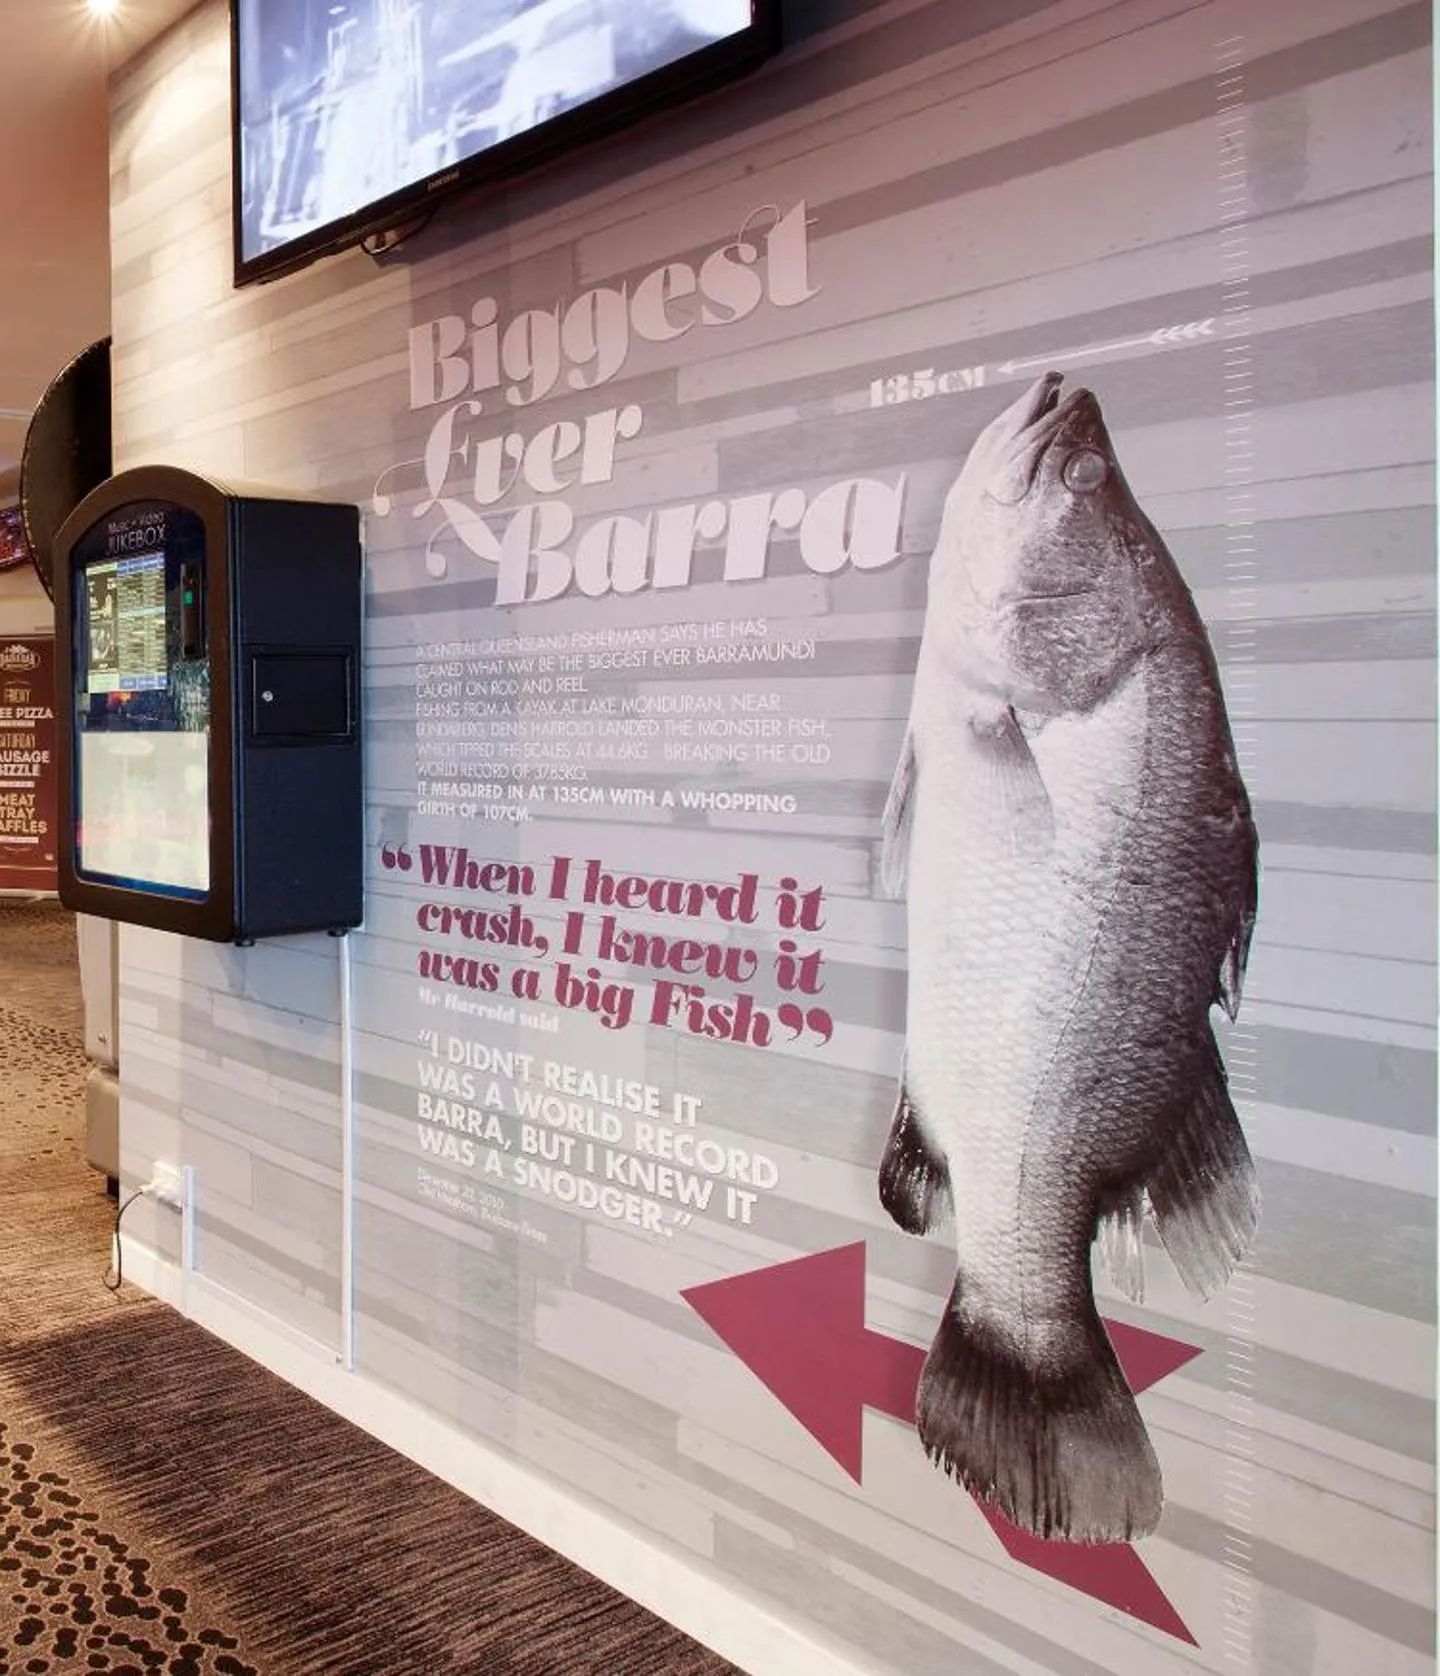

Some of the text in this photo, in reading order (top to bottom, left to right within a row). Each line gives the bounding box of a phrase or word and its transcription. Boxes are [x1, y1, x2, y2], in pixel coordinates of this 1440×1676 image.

[408, 200, 822, 410] Biggest
[870, 366, 987, 408] 135CM
[374, 401, 643, 540] Ever
[106, 523, 166, 555] JUKEBOX
[428, 472, 908, 607] Barra
[427, 642, 476, 659] CENTRAL
[479, 634, 568, 655] QUEENSLAND
[571, 628, 655, 649] FISHERMAN
[661, 623, 698, 642] SAYS
[703, 621, 725, 639] HE
[730, 618, 768, 637] HAS
[467, 660, 504, 676] WHAT
[506, 658, 535, 675] MAY
[538, 656, 556, 673] BE
[560, 654, 584, 672] THE
[588, 650, 648, 670] BIGGEST
[653, 647, 691, 667] EVER
[696, 640, 817, 664] BARRAMUNDI
[416, 682, 463, 698] CAUGHT
[466, 682, 487, 697] ON
[490, 679, 519, 695] ROD
[522, 678, 553, 694] AND
[416, 702, 461, 718] FISHING
[464, 701, 497, 717] FROM
[500, 702, 512, 717] A
[560, 698, 576, 715] AT
[585, 696, 617, 714] LAKE
[731, 693, 782, 712] NEAR
[16, 707, 54, 719] PIZZA
[598, 720, 660, 737] LANDED
[664, 719, 692, 737] THE
[698, 719, 782, 737] MONSTER
[416, 761, 458, 778] WORLD
[460, 762, 509, 779] RECORD
[512, 762, 531, 779] OF
[498, 743, 521, 758] THE
[523, 741, 572, 759] SCALES
[574, 741, 592, 759] AT
[664, 742, 749, 763] BREAKING
[754, 743, 785, 763] THE
[790, 743, 832, 765] OLD
[417, 780, 798, 815] IT MEASURED IN AT 135CM WITH A WHOPPING
[417, 799, 455, 816] GIRTH
[459, 800, 478, 818] OF
[548, 855, 573, 901] I
[583, 859, 759, 924] heard
[775, 876, 827, 932] it
[416, 902, 826, 995] crash, I knew it
[417, 949, 500, 993] was
[511, 966, 541, 1001] a
[554, 961, 635, 1030] big
[520, 1012, 560, 1033] said
[543, 1060, 662, 1120] REALISE
[673, 1090, 702, 1128] IT
[417, 1059, 779, 1189] WAS A WORLD RECORD
[417, 1123, 476, 1169] WAS
[484, 1149, 505, 1178] A
[417, 1090, 758, 1225] BARRA, BUT I KNEW IT
